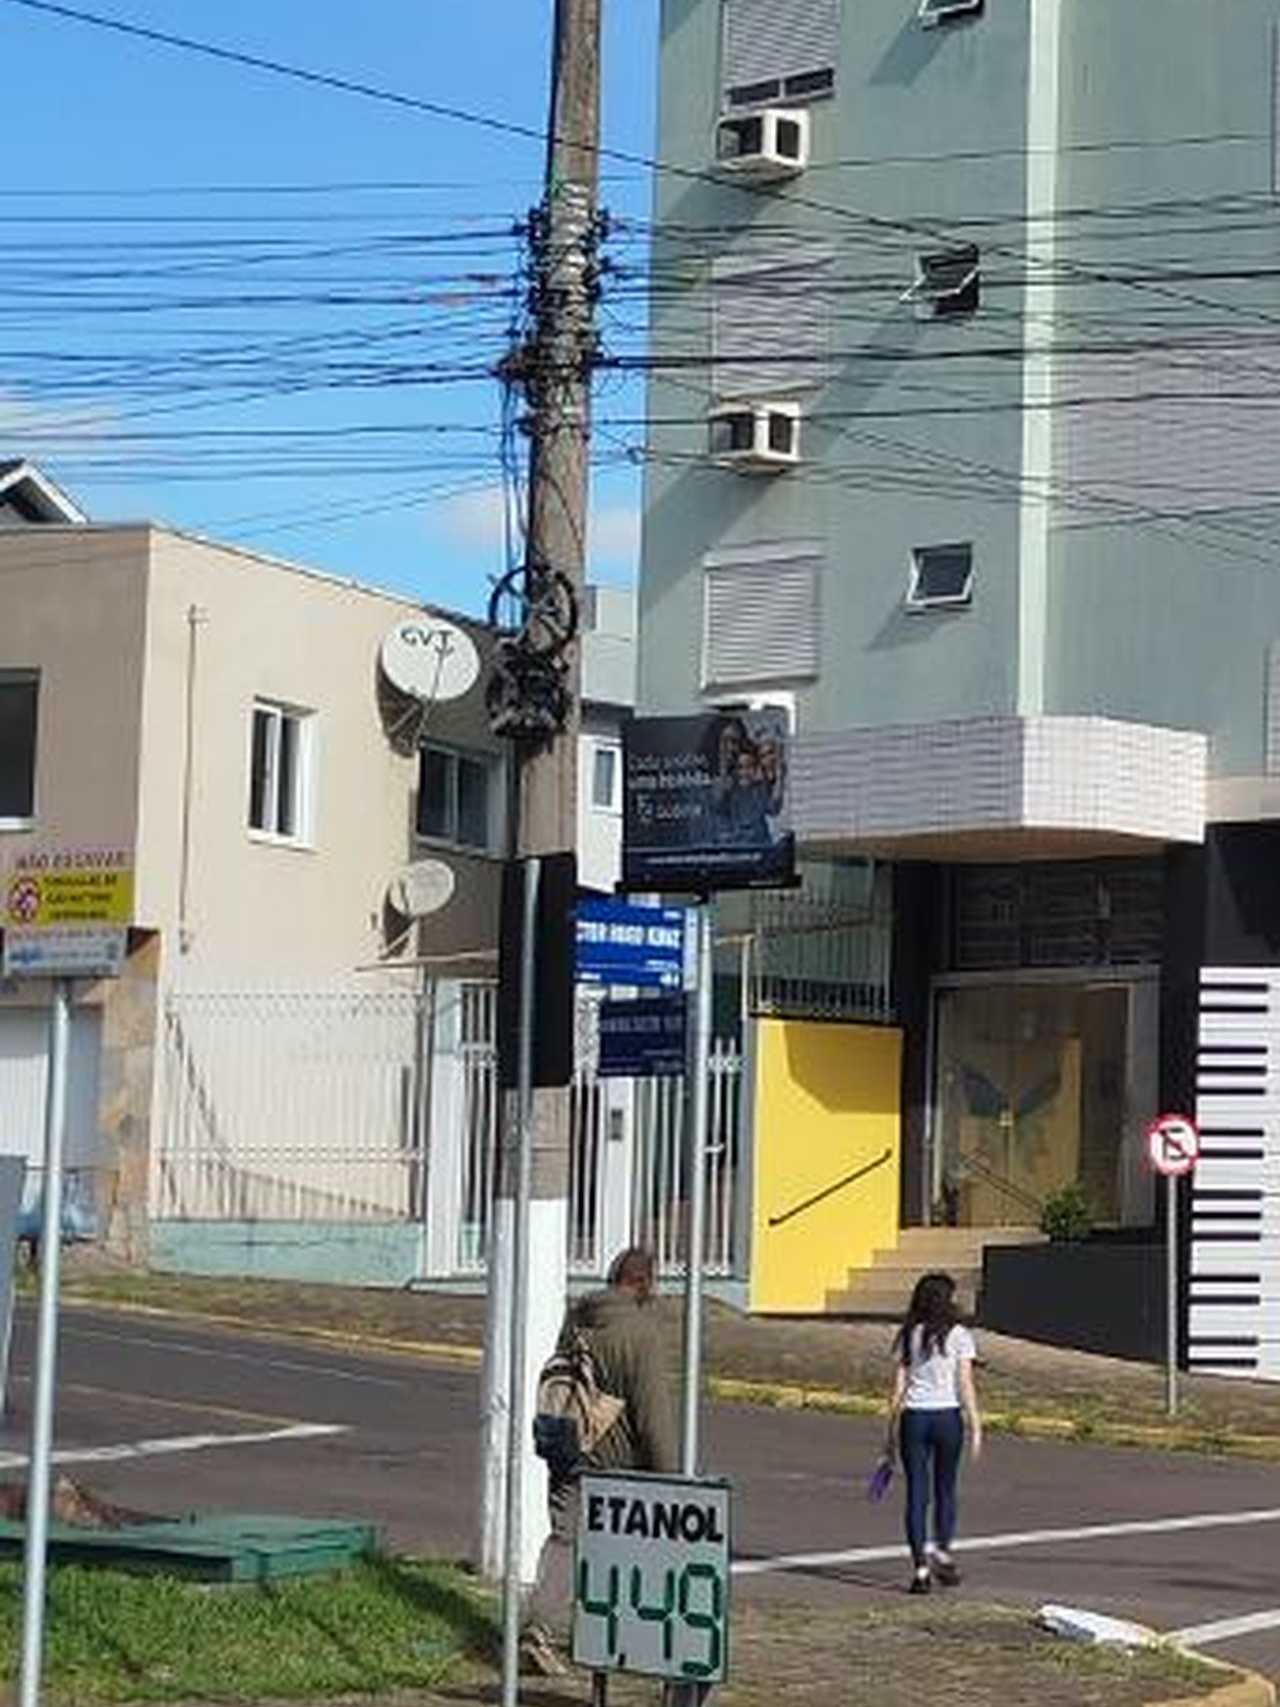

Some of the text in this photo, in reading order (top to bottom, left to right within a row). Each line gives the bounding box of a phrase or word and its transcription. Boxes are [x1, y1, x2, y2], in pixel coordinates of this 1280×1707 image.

[400, 626, 454, 651] GVT
[588, 1496, 723, 1543] ETANOL
[580, 1558, 720, 1676] 4,49
